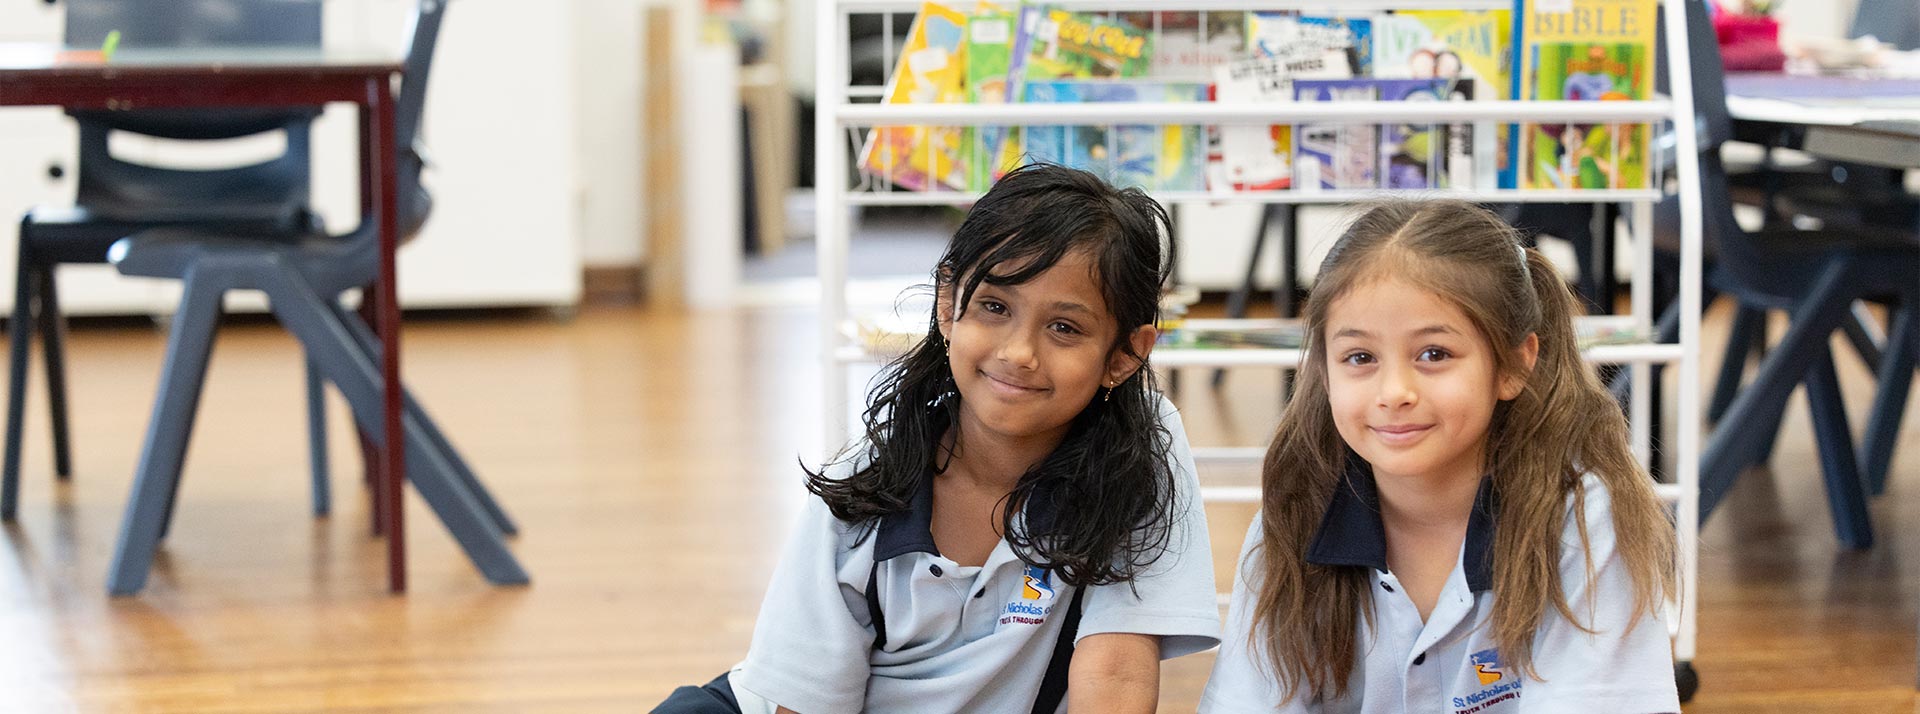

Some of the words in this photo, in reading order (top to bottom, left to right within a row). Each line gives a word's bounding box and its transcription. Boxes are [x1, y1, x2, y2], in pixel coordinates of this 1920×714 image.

[1533, 6, 1640, 36] BIBLE
[1007, 602, 1043, 616] Nicholas
[1012, 616, 1044, 625] THROUGH
[1453, 696, 1466, 708] St
[1466, 683, 1511, 706] Nicholas
[1481, 692, 1515, 709] THROUGH
